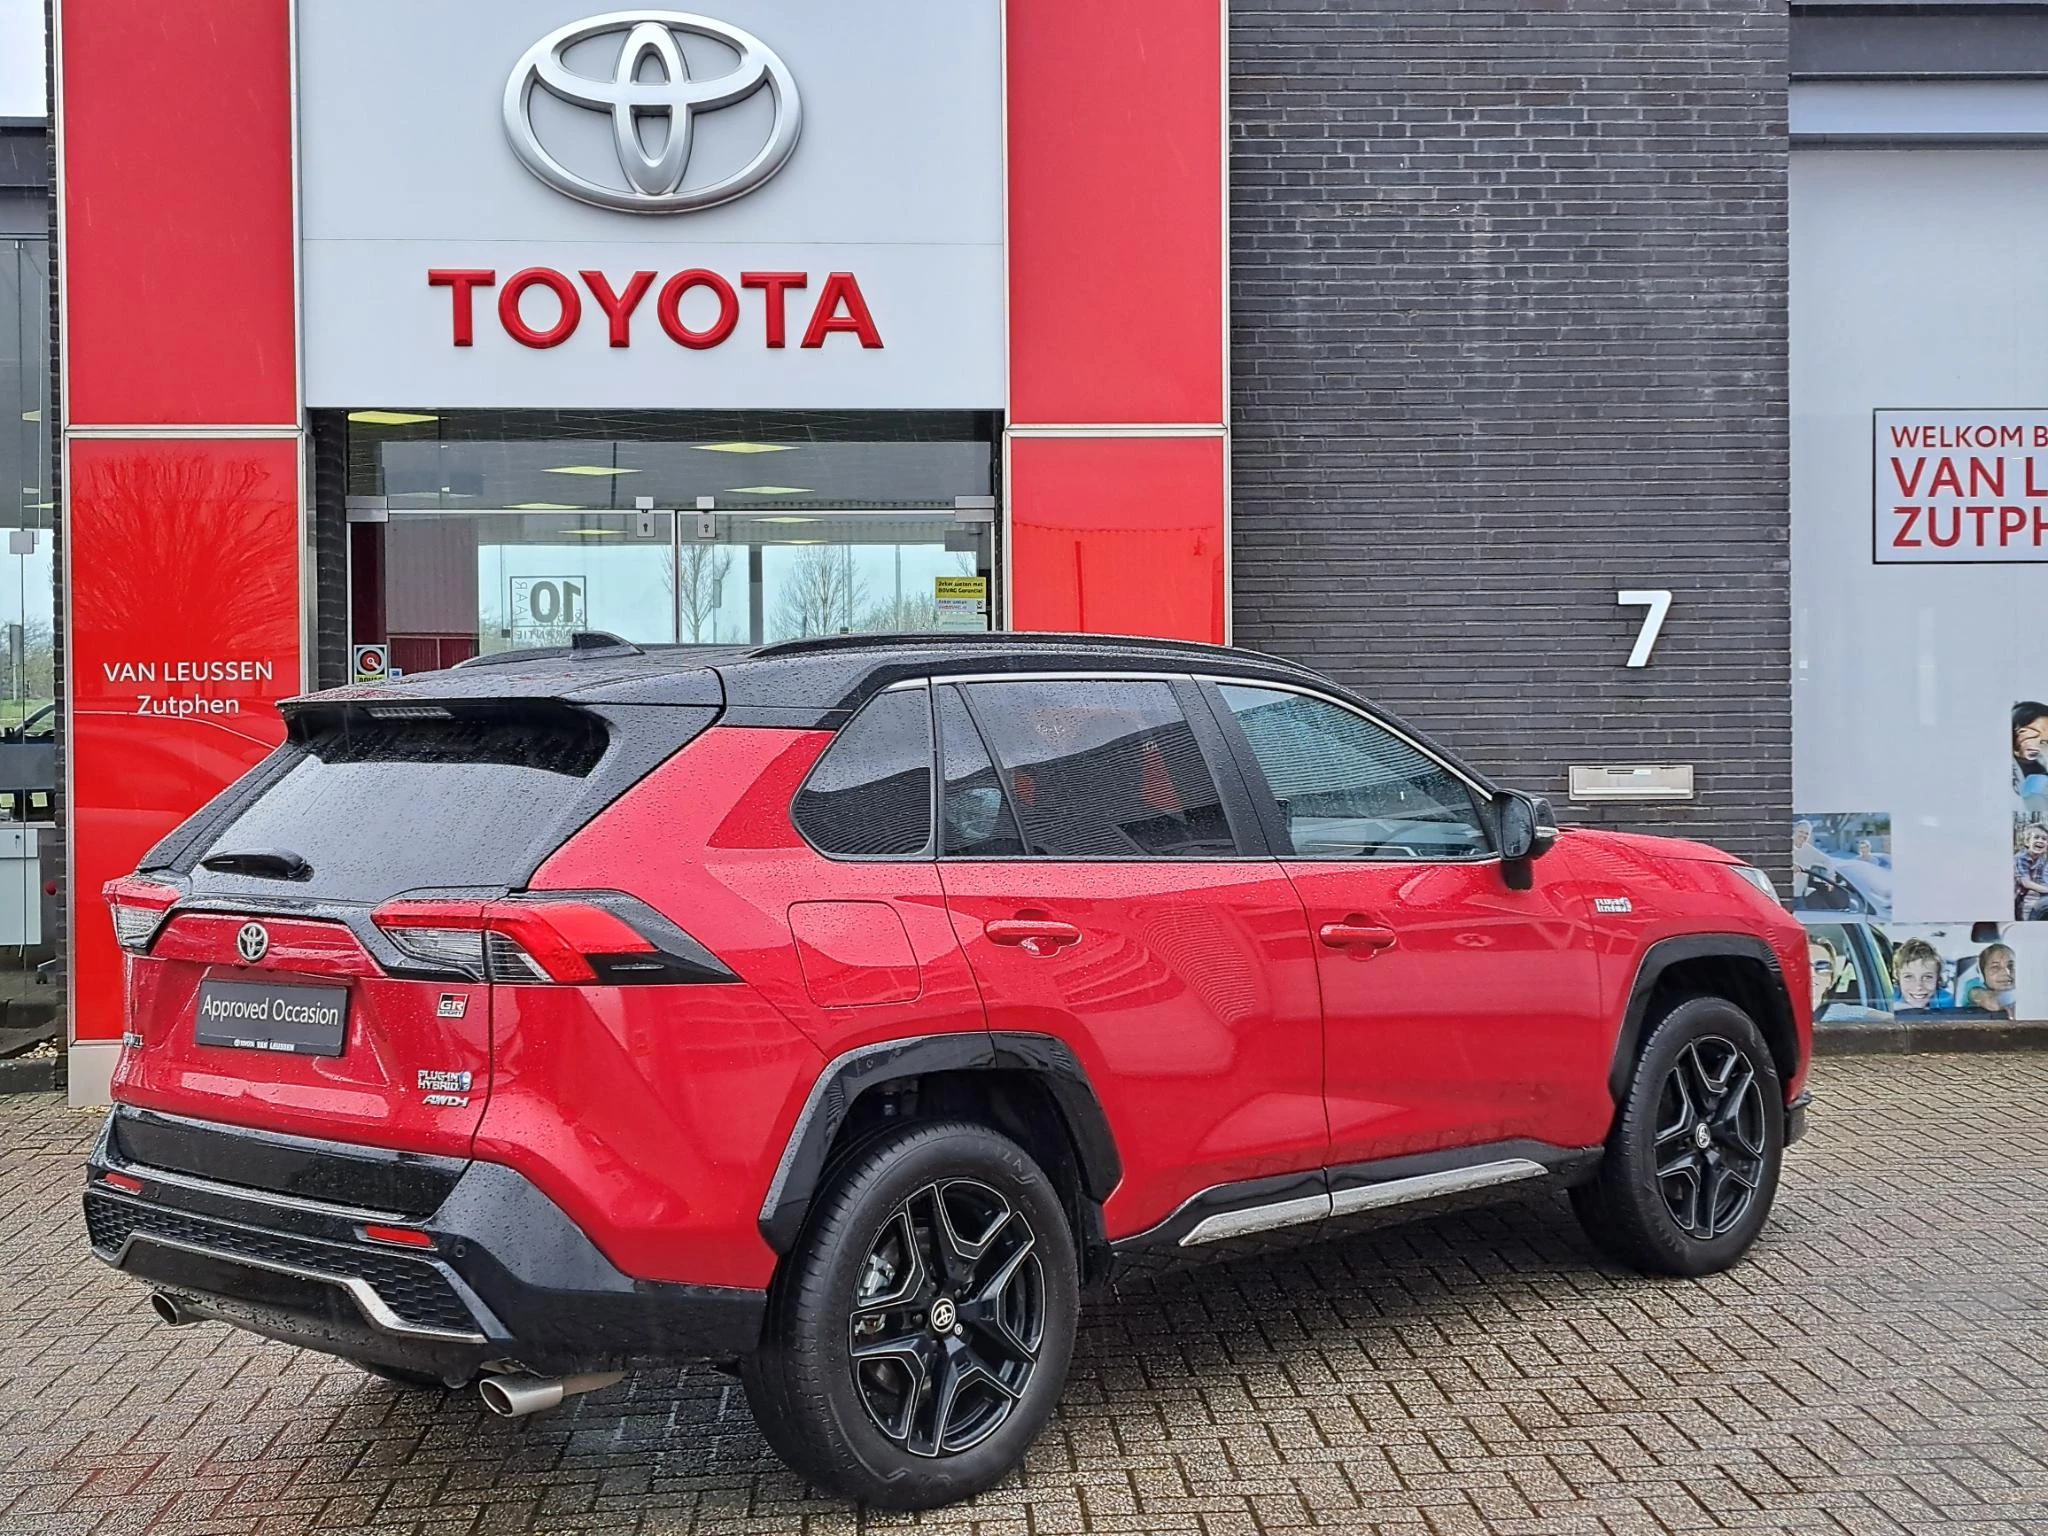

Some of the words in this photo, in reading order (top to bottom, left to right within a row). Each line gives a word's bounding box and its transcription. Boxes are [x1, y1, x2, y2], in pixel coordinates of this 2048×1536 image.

[428, 267, 884, 350] TOYOTA
[1890, 426, 2023, 448] WELKOM
[1890, 457, 2004, 498] VAN
[1618, 590, 1672, 667] 7
[103, 662, 156, 682] VAN
[164, 660, 273, 682] LEUSSEN
[137, 693, 239, 719] Zutphen
[201, 994, 270, 1022] Approved
[272, 999, 339, 1026] Occasion
[441, 1001, 464, 1011] GR
[417, 1080, 459, 1092] HYBRID
